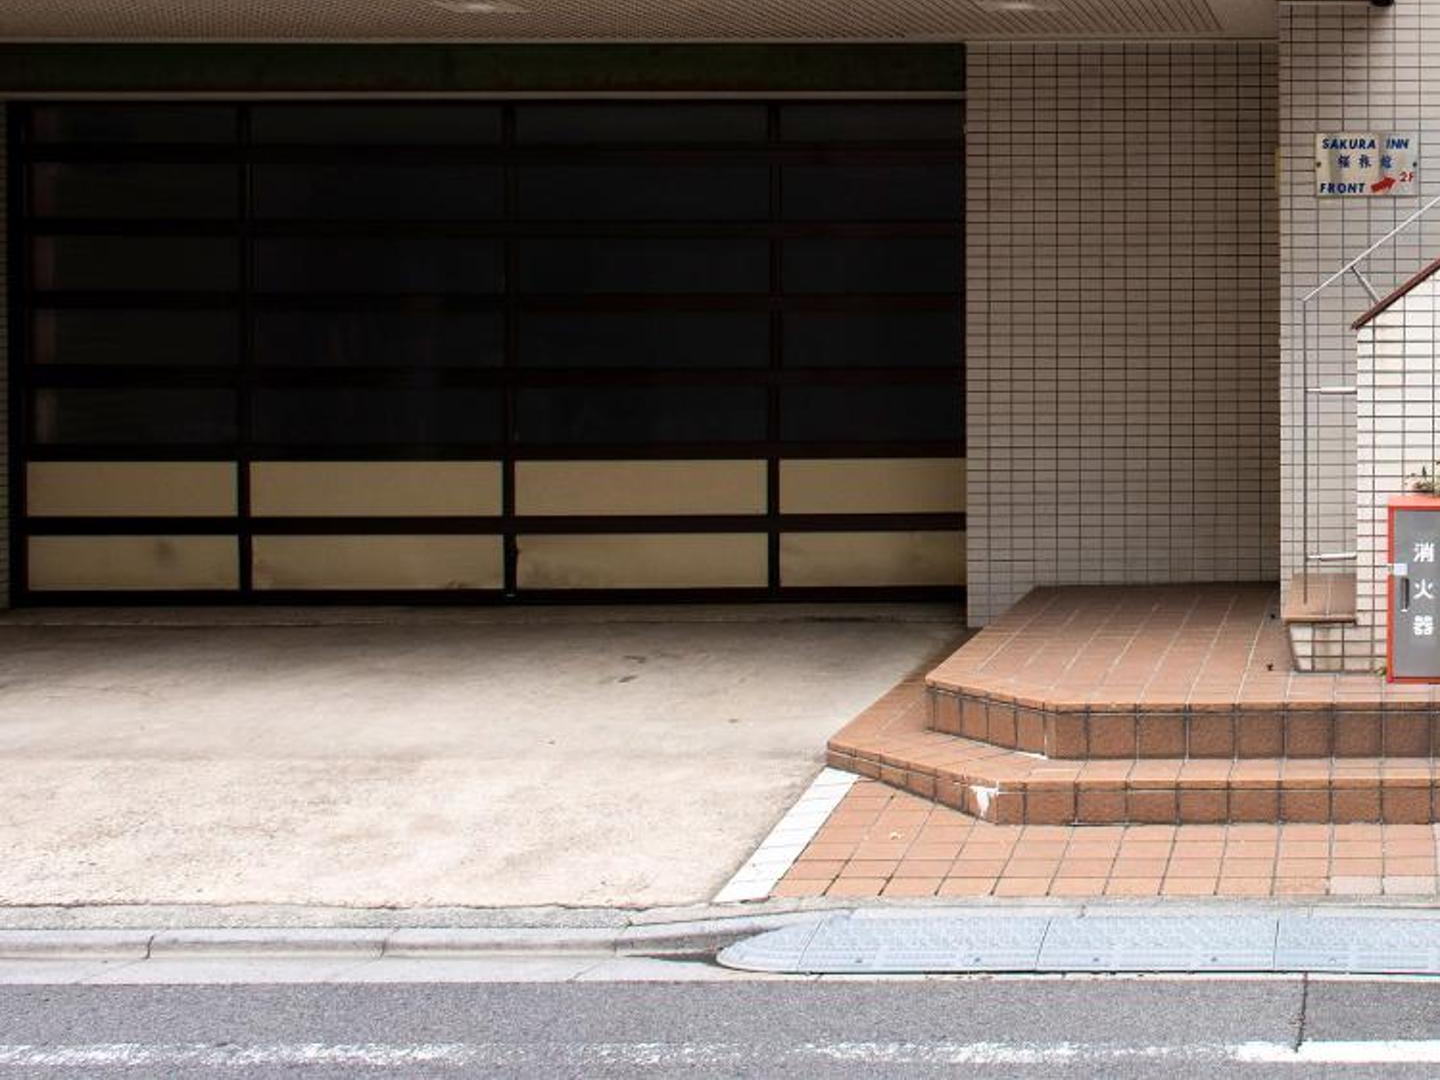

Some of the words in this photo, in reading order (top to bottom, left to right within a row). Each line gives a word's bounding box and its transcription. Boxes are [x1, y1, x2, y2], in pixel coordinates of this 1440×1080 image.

[1322, 138, 1376, 149] SAKURA
[1385, 138, 1410, 149] INN
[1320, 182, 1366, 194] FRONT
[1413, 542, 1435, 636] 消火器
